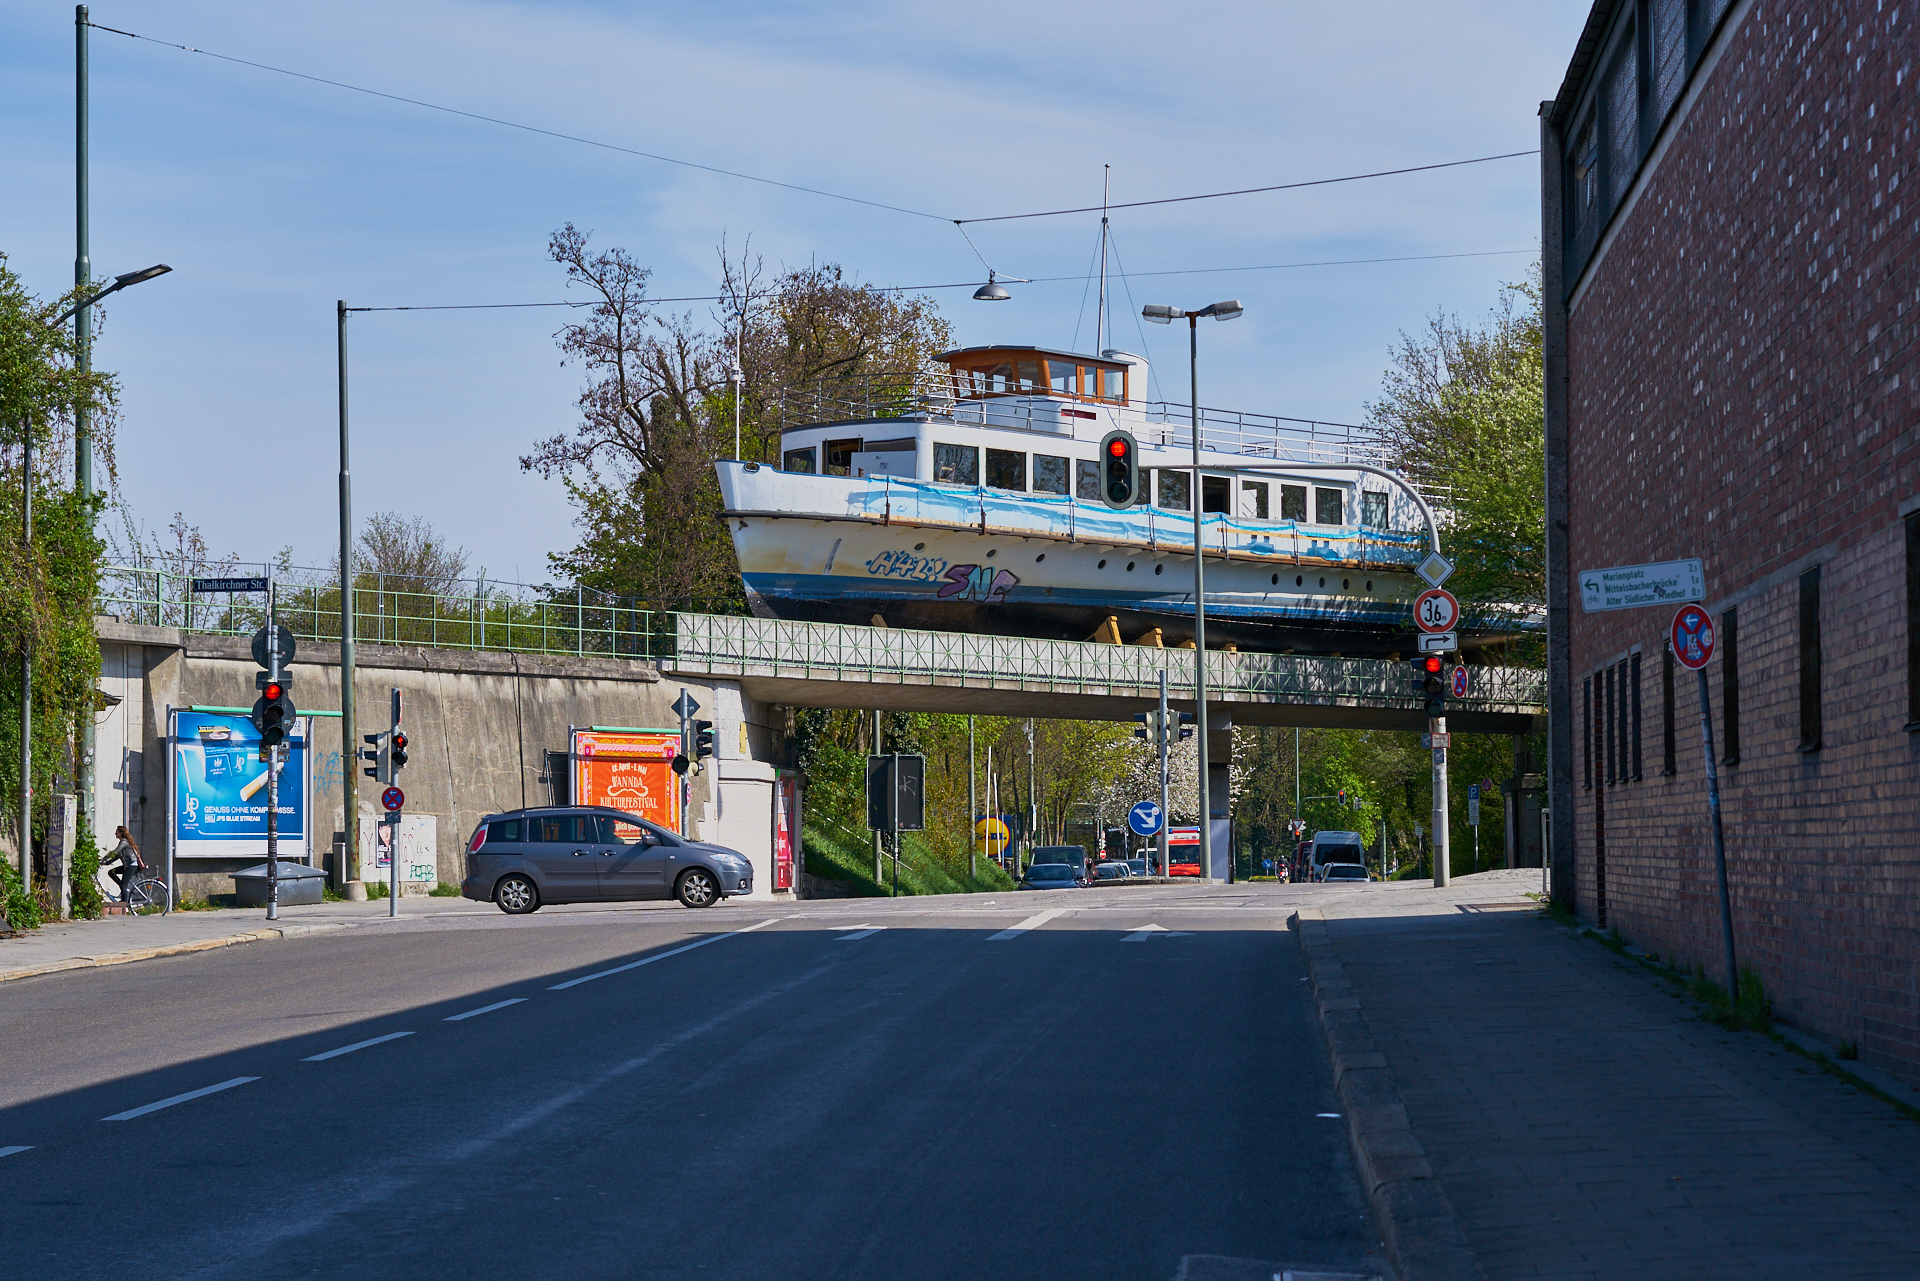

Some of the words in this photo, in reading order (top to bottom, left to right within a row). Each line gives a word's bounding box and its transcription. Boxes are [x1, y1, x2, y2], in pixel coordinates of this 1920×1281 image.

[1602, 570, 1644, 582] Marienplatz
[197, 580, 249, 590] Thalkirchner
[251, 580, 264, 590] Str.
[1604, 579, 1678, 594] Wittelsbacherbrücke
[1606, 597, 1622, 606] Alter
[1624, 593, 1656, 604] Südlicher
[1424, 599, 1442, 624] 3,6
[612, 776, 643, 788] WANNDA
[1470, 787, 1477, 799] P
[600, 797, 658, 809] KULTURFESTIVAL
[204, 806, 230, 814] GENUSS
[231, 806, 249, 814] OHNE
[250, 806, 296, 814] KOMPMISSE.
